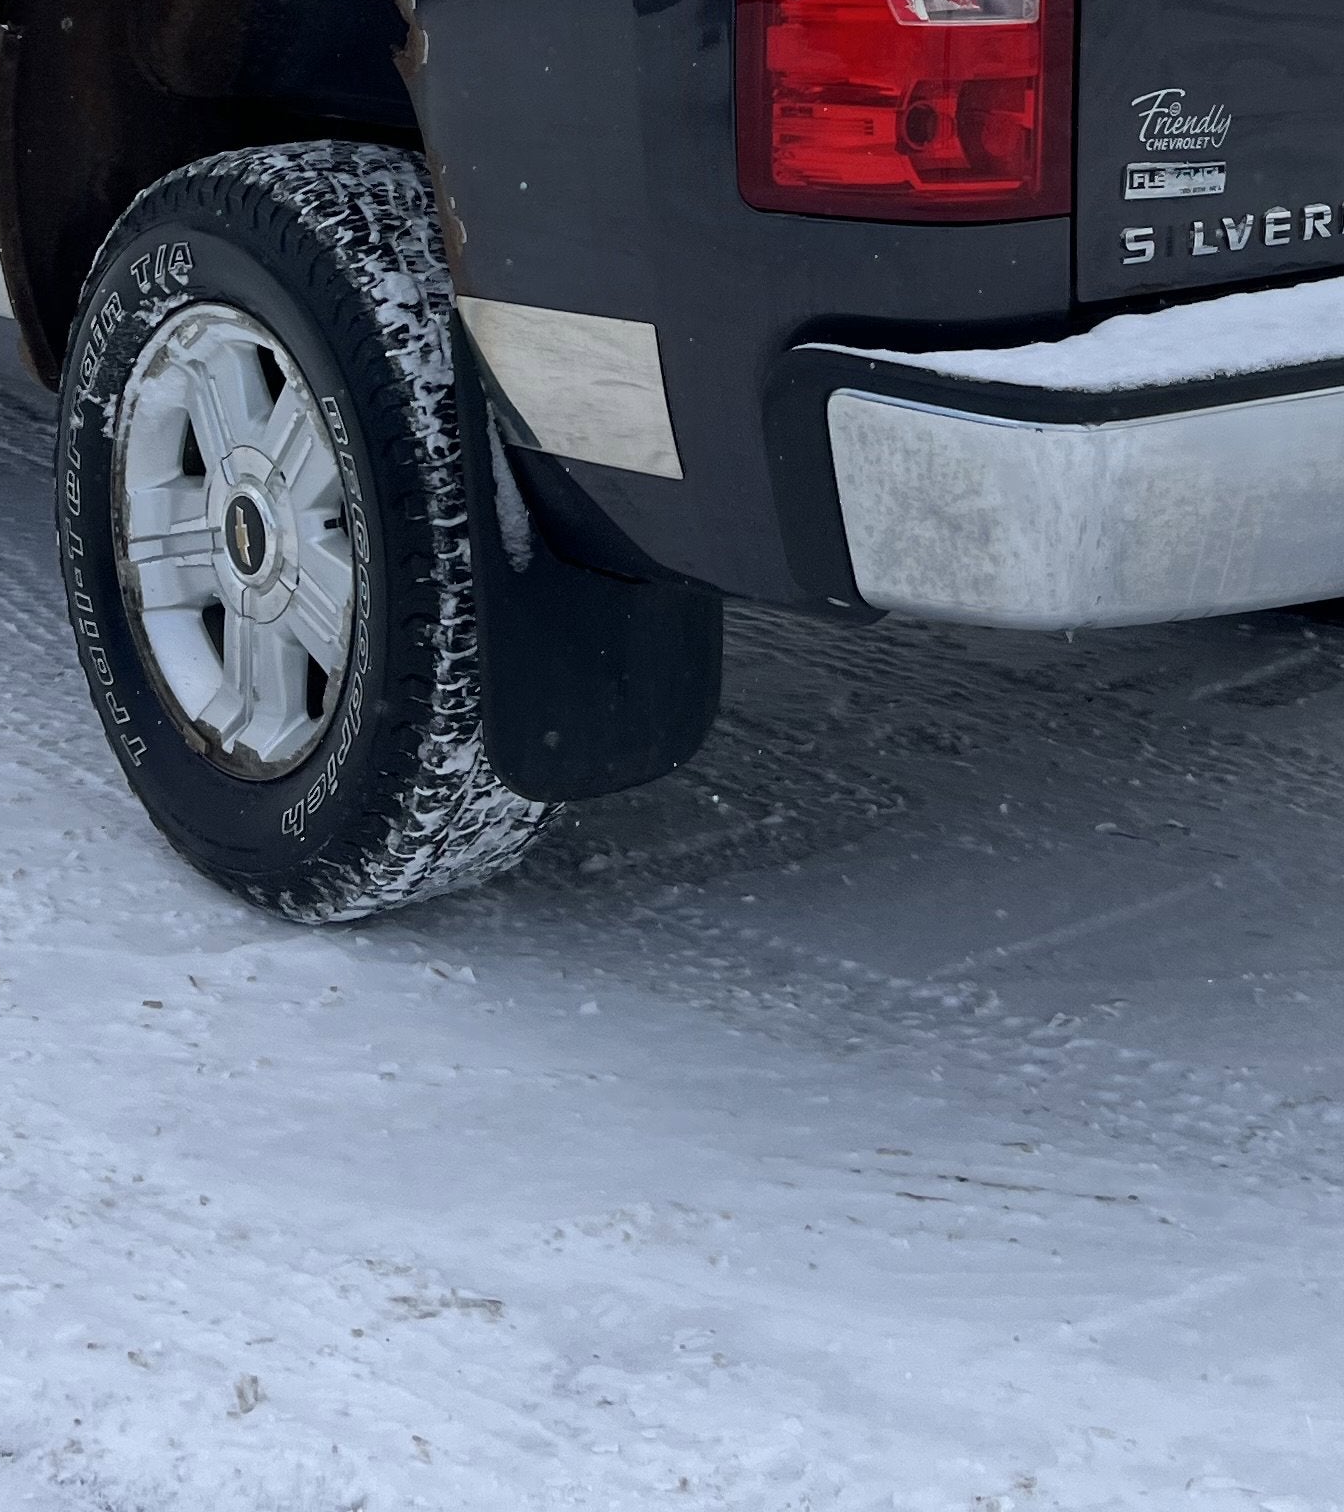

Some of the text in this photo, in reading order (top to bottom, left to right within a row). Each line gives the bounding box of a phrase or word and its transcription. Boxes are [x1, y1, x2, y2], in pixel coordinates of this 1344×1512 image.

[1131, 88, 1232, 148] Friendly
[1146, 136, 1211, 151] CHEVROLET
[130, 241, 193, 291] T/A
[280, 395, 372, 839] BFGoodrich
